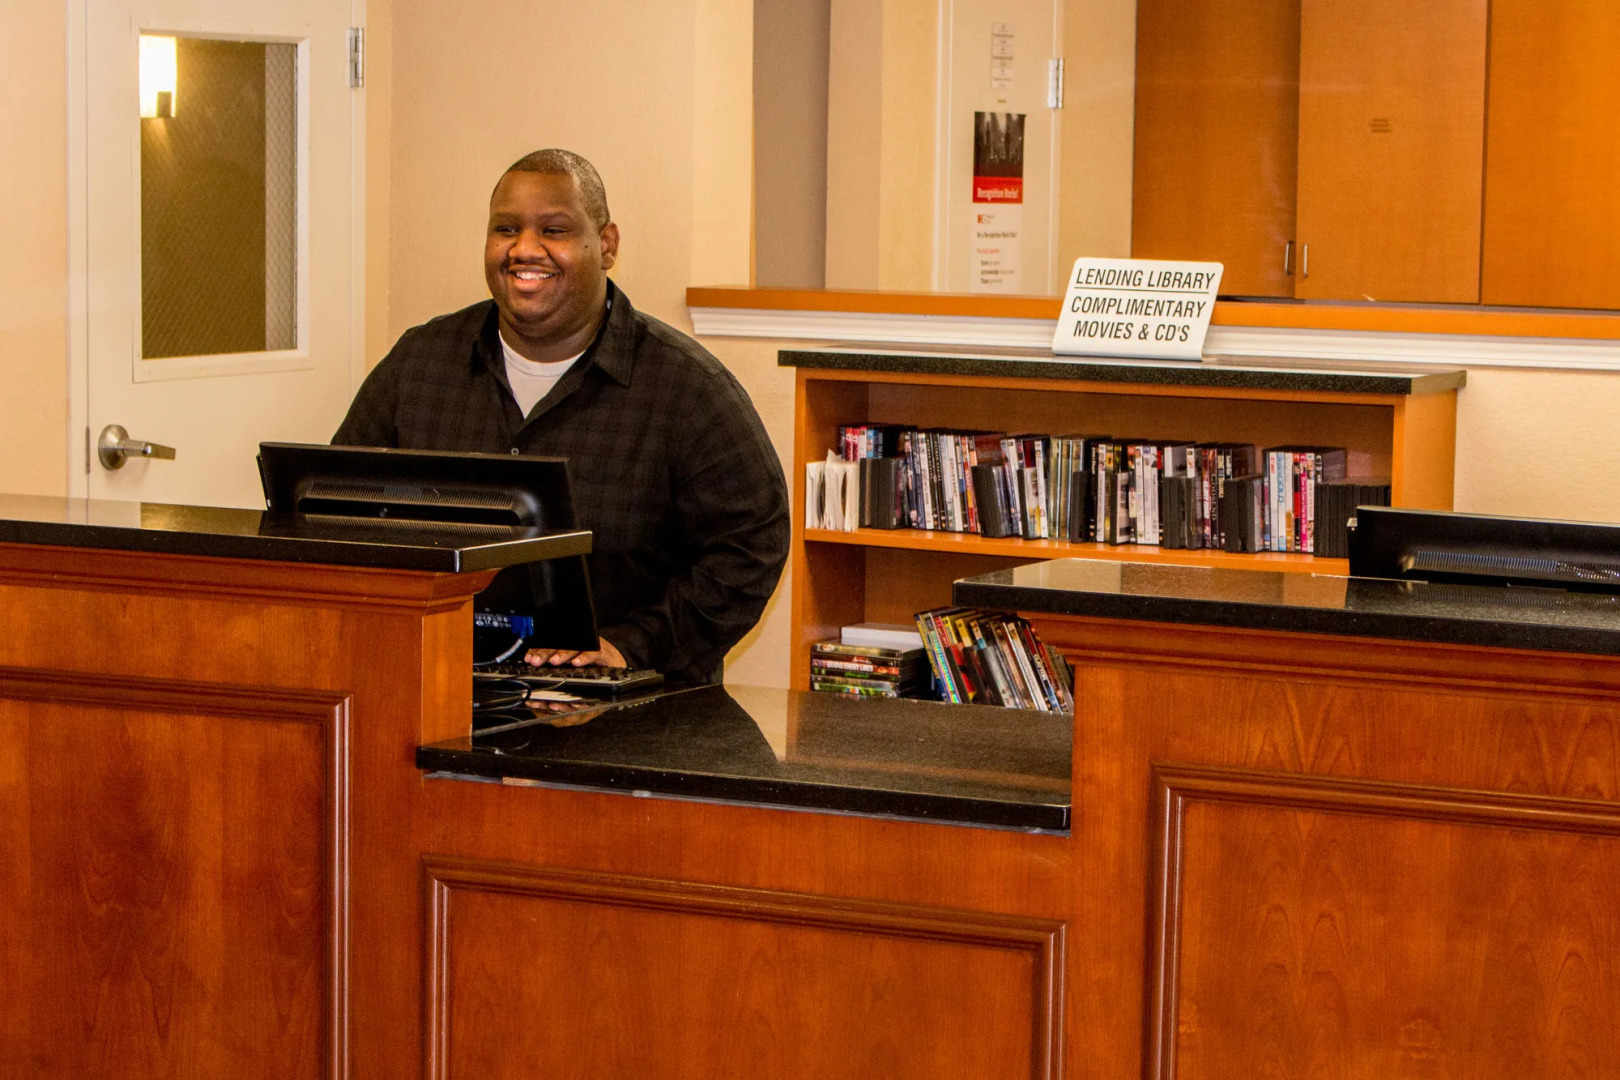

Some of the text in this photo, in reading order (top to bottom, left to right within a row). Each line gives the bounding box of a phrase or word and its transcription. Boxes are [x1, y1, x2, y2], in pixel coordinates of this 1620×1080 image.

[1076, 268, 1216, 290] LENDING LIBRARY
[1071, 296, 1207, 318] COMPLIMENTARY
[1073, 320, 1190, 342] MOVIES & CD'S
